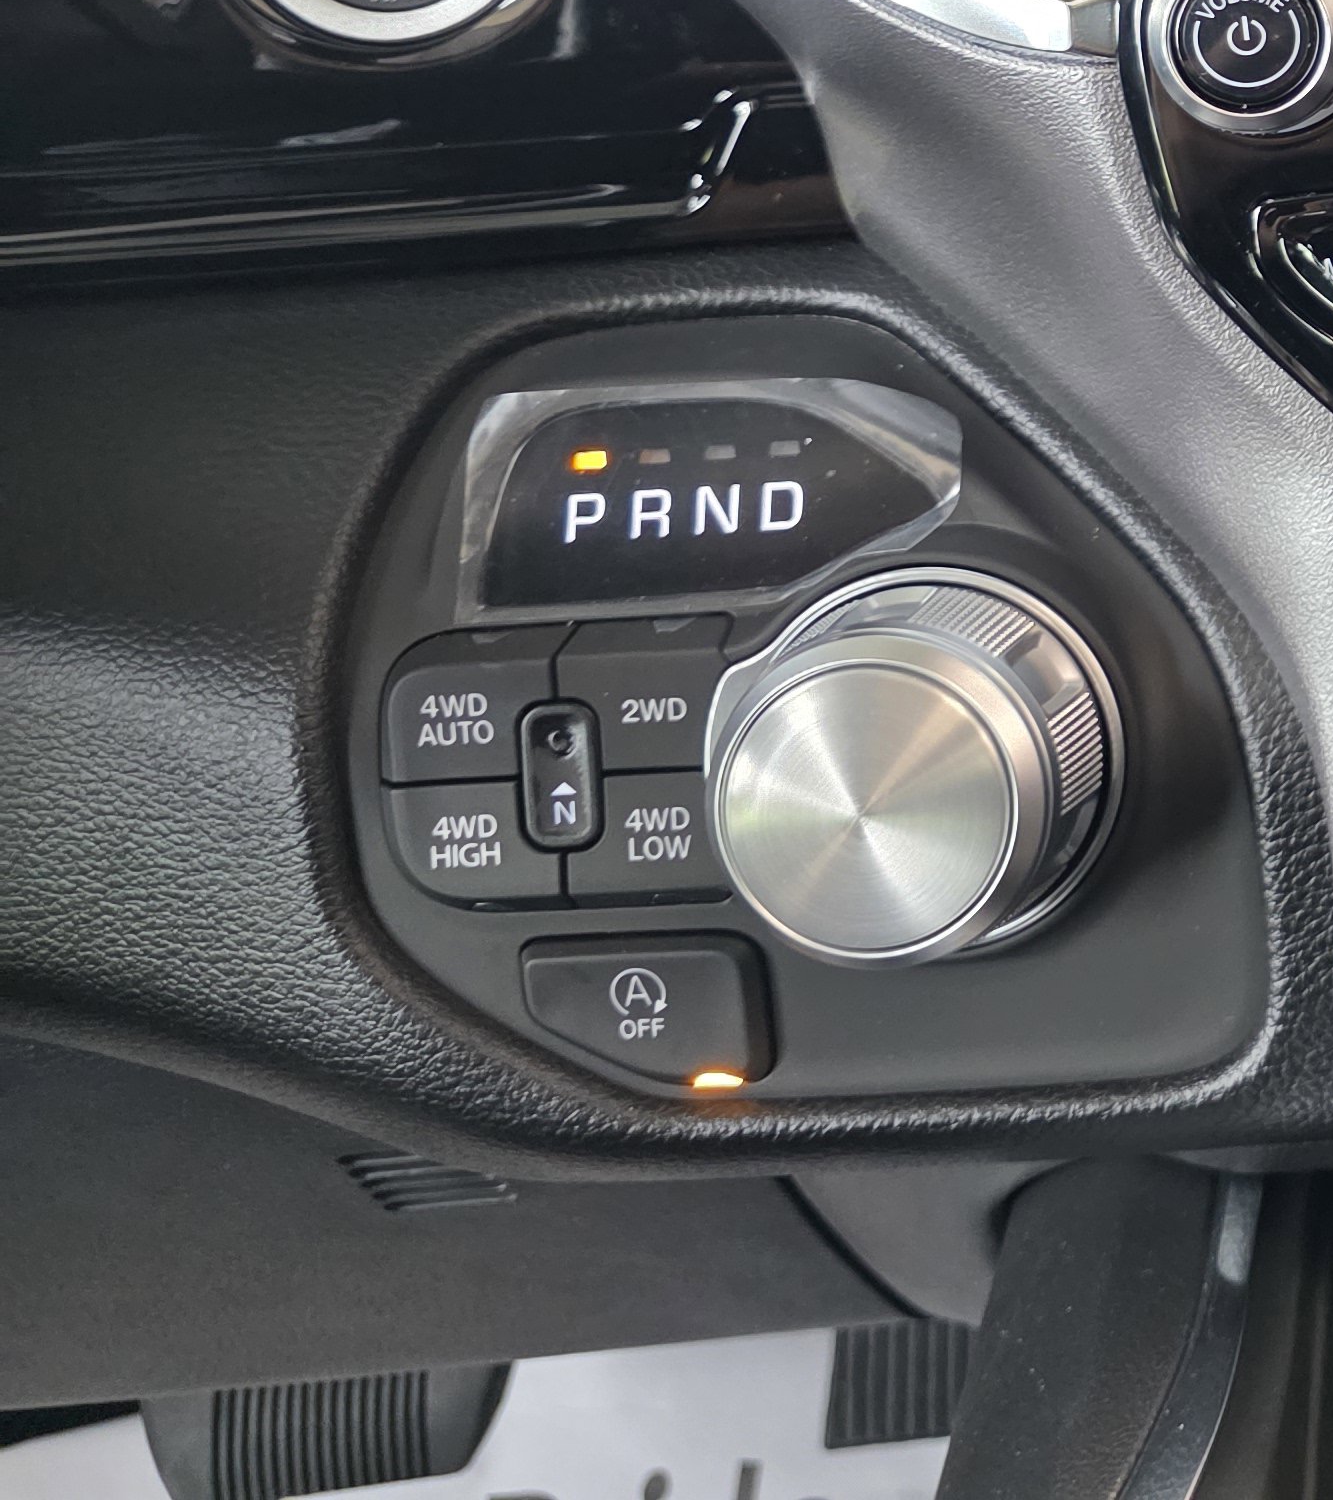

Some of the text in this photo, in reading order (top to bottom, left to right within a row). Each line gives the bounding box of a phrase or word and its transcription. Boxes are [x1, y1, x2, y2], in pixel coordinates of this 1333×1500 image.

[419, 693, 488, 718] 4WD
[620, 698, 688, 724] 2WD
[417, 719, 495, 747] AUTO
[552, 801, 577, 826] N
[624, 807, 691, 832] 4WD
[432, 814, 498, 840] 4WD
[430, 841, 502, 870] HIGH
[627, 835, 692, 862] LOW
[618, 1017, 665, 1041] OFF
